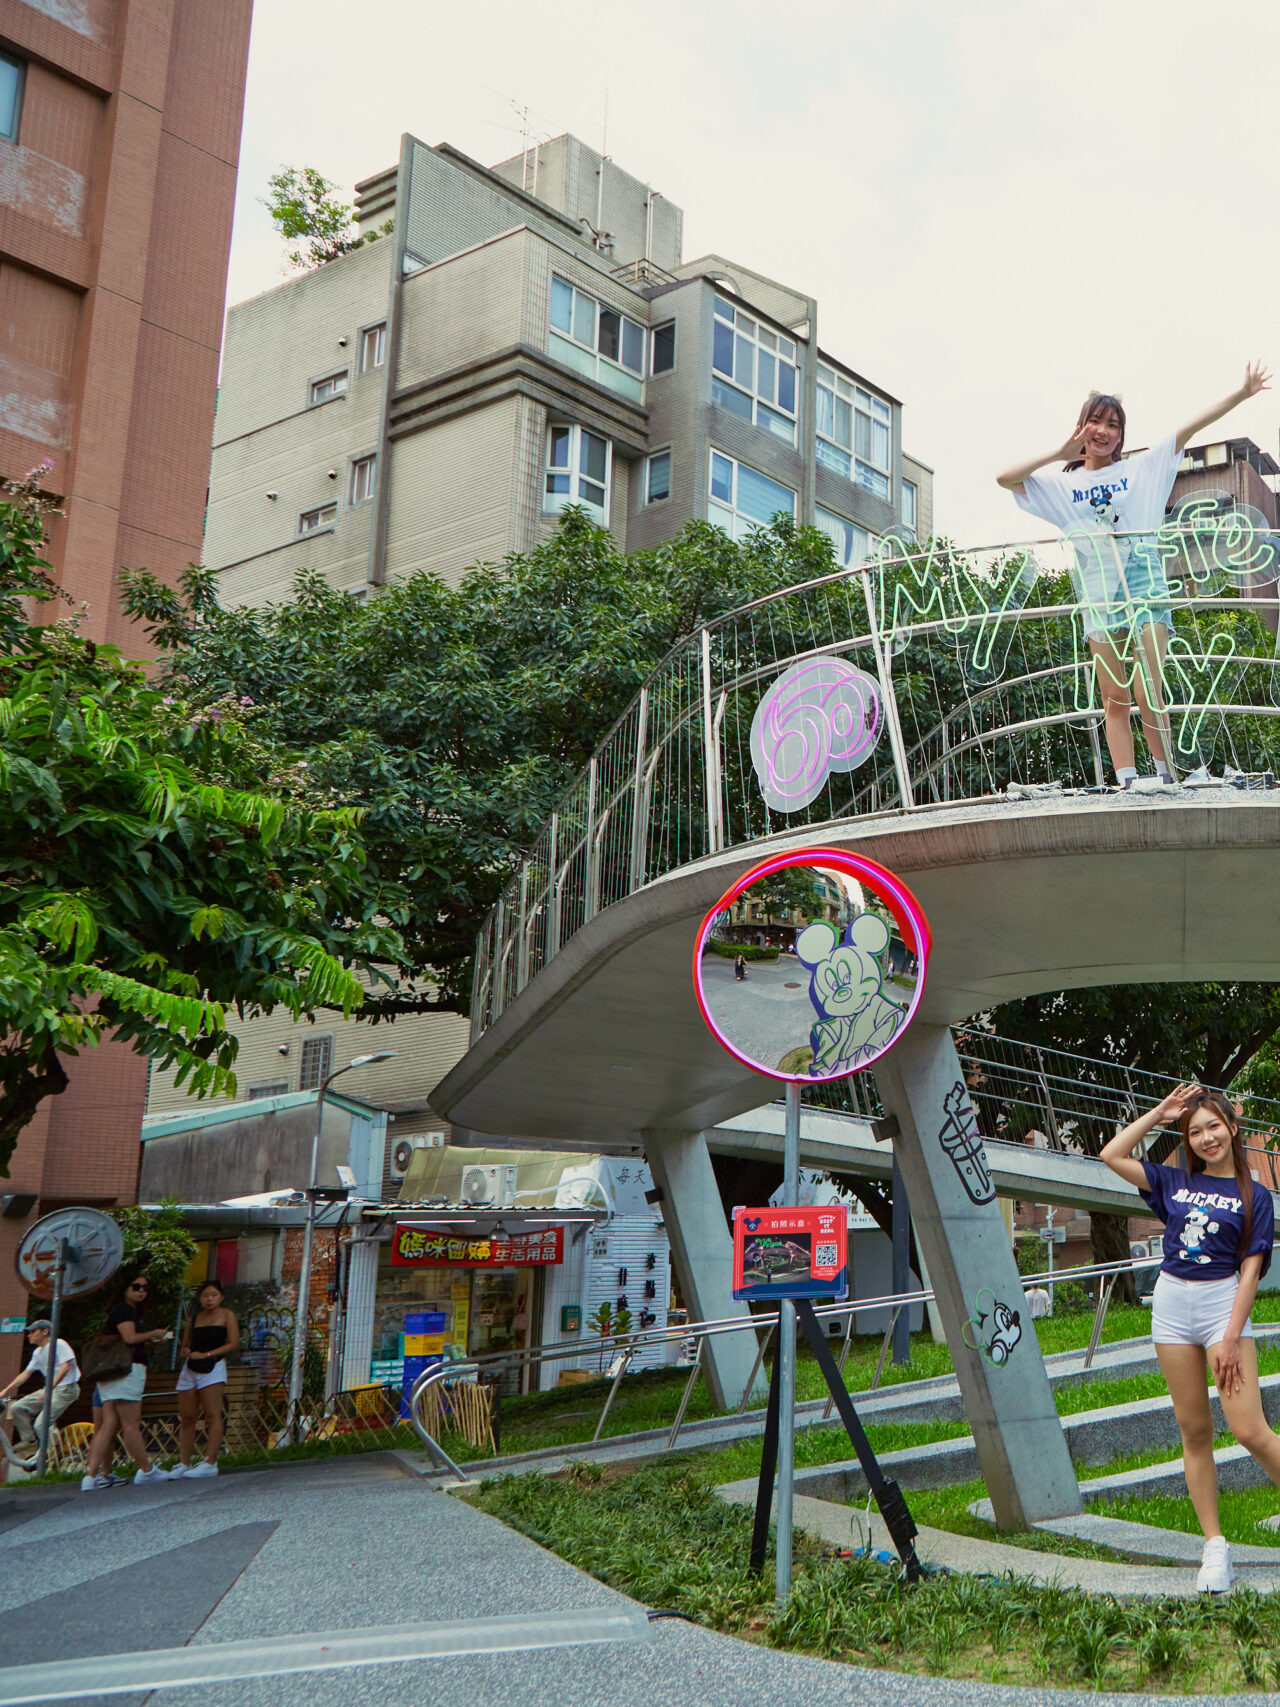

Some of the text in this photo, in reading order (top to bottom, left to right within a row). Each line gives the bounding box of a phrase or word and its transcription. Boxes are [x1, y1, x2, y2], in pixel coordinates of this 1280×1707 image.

[1072, 478, 1128, 503] MICKEY
[1171, 1188, 1243, 1213] MICKEY
[494, 1246, 557, 1262] 生活用品
